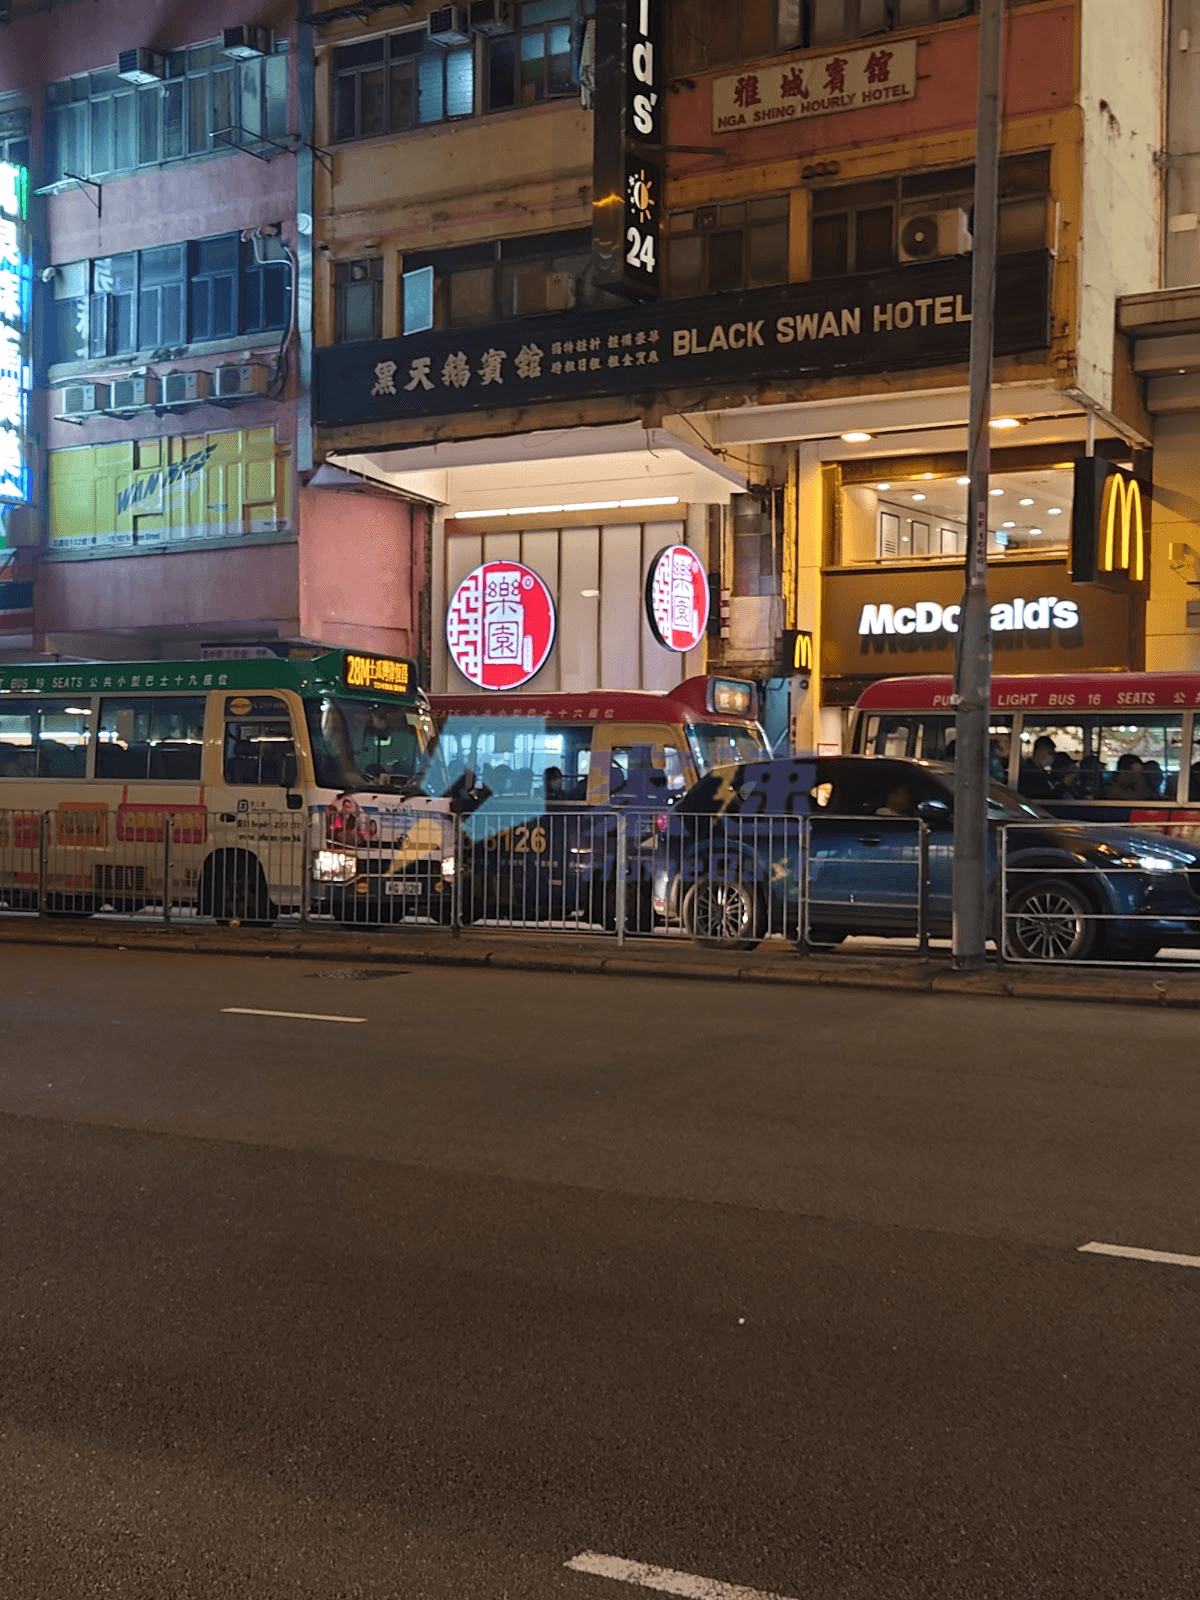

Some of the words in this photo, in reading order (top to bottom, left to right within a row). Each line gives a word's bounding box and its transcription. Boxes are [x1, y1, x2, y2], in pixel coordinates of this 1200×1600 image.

[717, 113, 746, 129] NGA
[752, 104, 796, 122] SHING
[800, 92, 857, 114] HOURLY
[861, 83, 910, 103] HOTEL
[626, 226, 655, 273] 24
[672, 319, 765, 357] BLACK
[775, 306, 861, 344] SWAN
[873, 294, 974, 333] HOTEL
[486, 575, 521, 660] 樂園
[858, 597, 1080, 635] McDoald's
[51, 676, 84, 689] SEATS
[346, 654, 371, 687] 28M
[997, 693, 1039, 706] LIGHT
[1048, 693, 1076, 706] BUS
[1087, 693, 1102, 705] 16
[1116, 691, 1156, 705] SEATS
